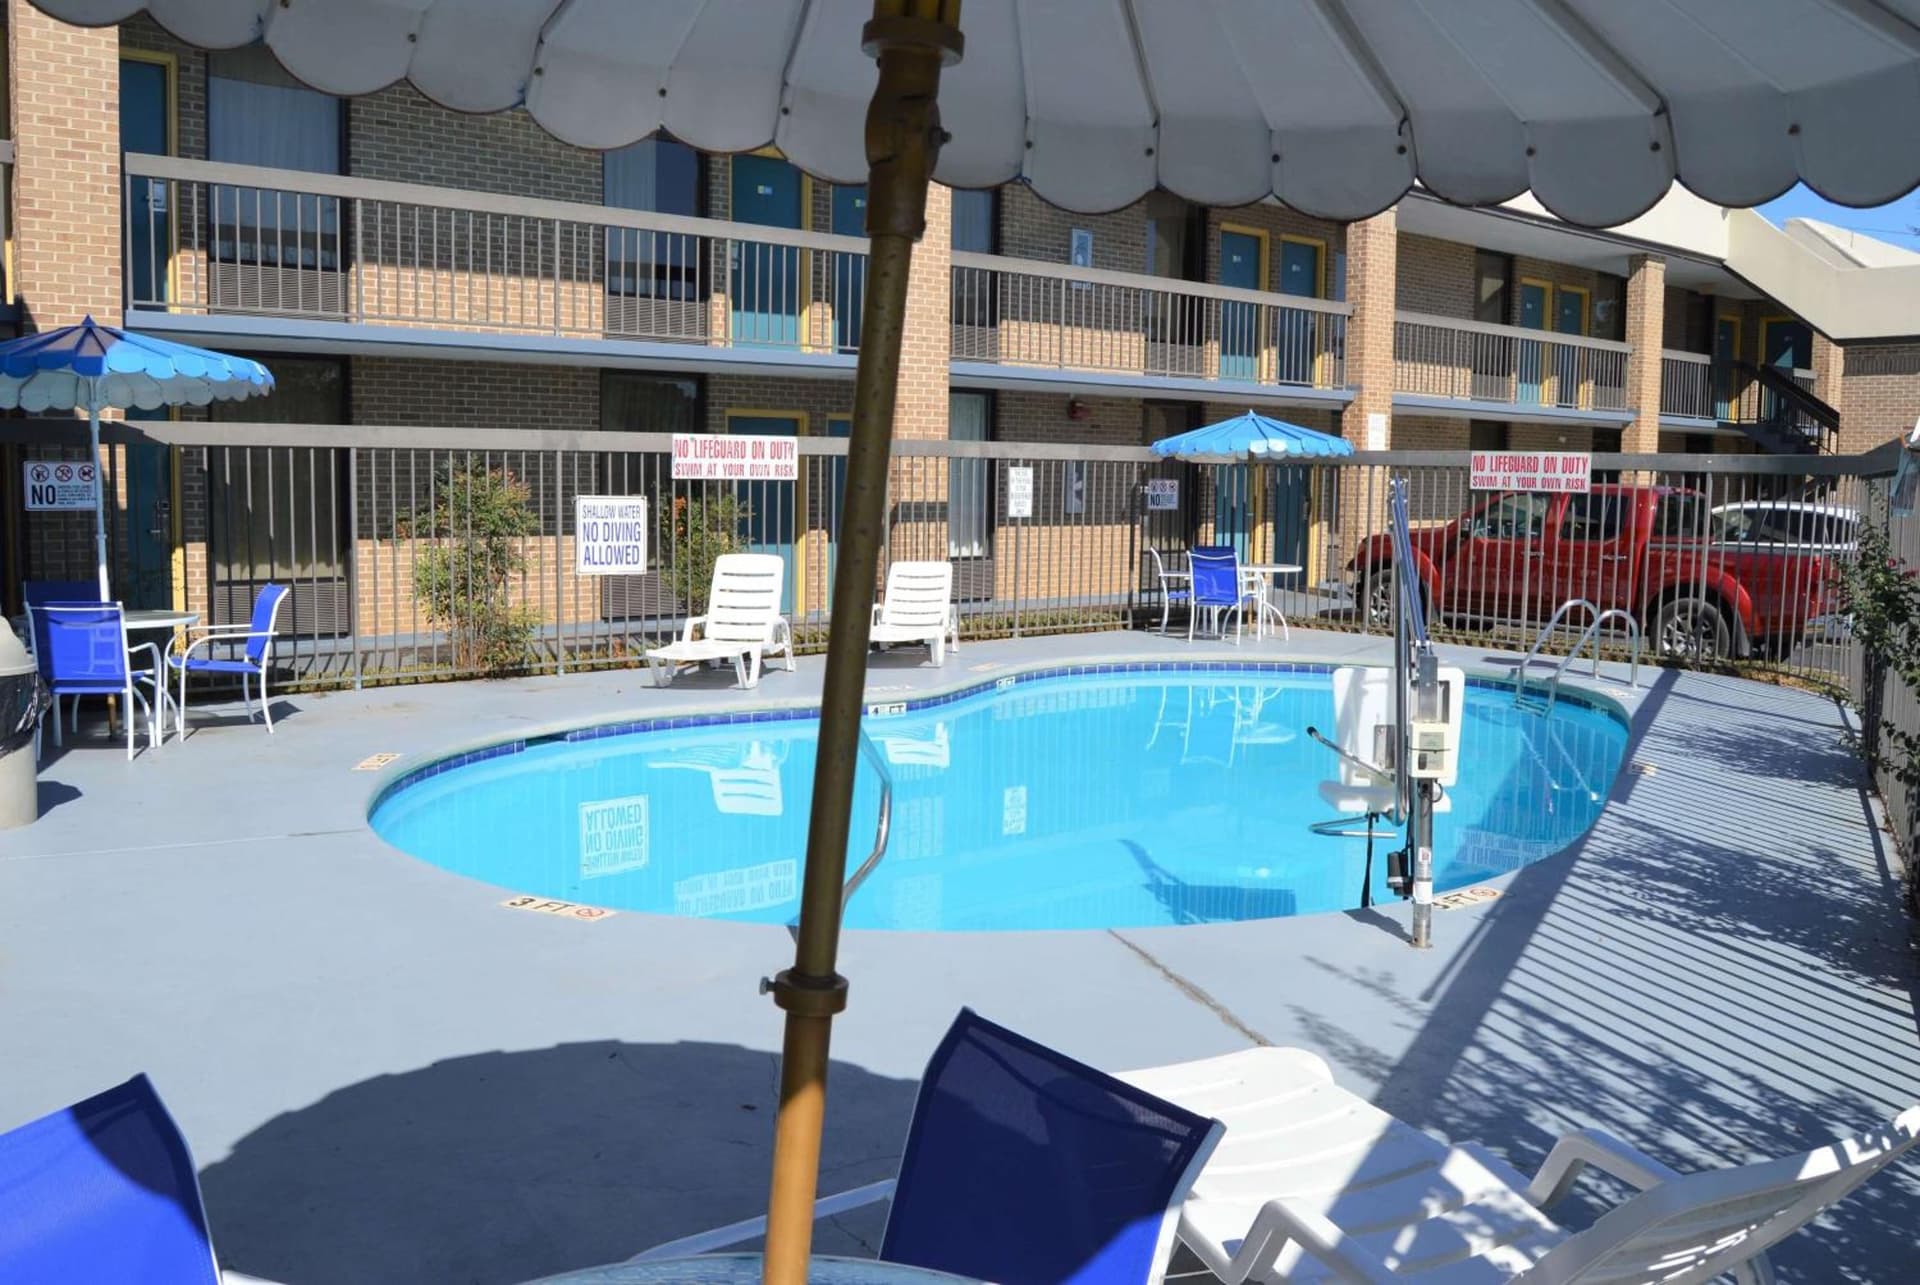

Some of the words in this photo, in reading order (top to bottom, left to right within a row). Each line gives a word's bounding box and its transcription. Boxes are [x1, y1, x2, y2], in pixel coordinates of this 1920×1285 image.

[674, 440, 689, 458] NO
[694, 440, 746, 459] LIFEGUARD
[752, 441, 765, 459] ON
[770, 441, 795, 460] DUTY
[675, 463, 702, 476] SWIM
[707, 463, 717, 476] AT
[722, 463, 745, 476] YOUR
[750, 464, 770, 477] OWN
[774, 464, 795, 477] RISK
[1472, 455, 1486, 472] NO
[1490, 455, 1539, 473] LIFEGUARD
[1543, 456, 1557, 473] ON
[1562, 456, 1589, 474] DUTY
[1472, 475, 1497, 487] SWIM
[1502, 476, 1511, 488] AT
[1516, 476, 1537, 488] YOUR
[1541, 477, 1561, 489] OWN
[1565, 477, 1586, 489] RISK
[31, 484, 56, 505] NO
[1150, 493, 1161, 506] NO
[582, 504, 617, 519] SHALLOW
[617, 504, 641, 519] WATER
[583, 521, 599, 543] NO
[602, 521, 641, 542] DIVING
[583, 544, 640, 566] ALLOWED
[509, 897, 536, 907] 3
[533, 901, 577, 912] FT
